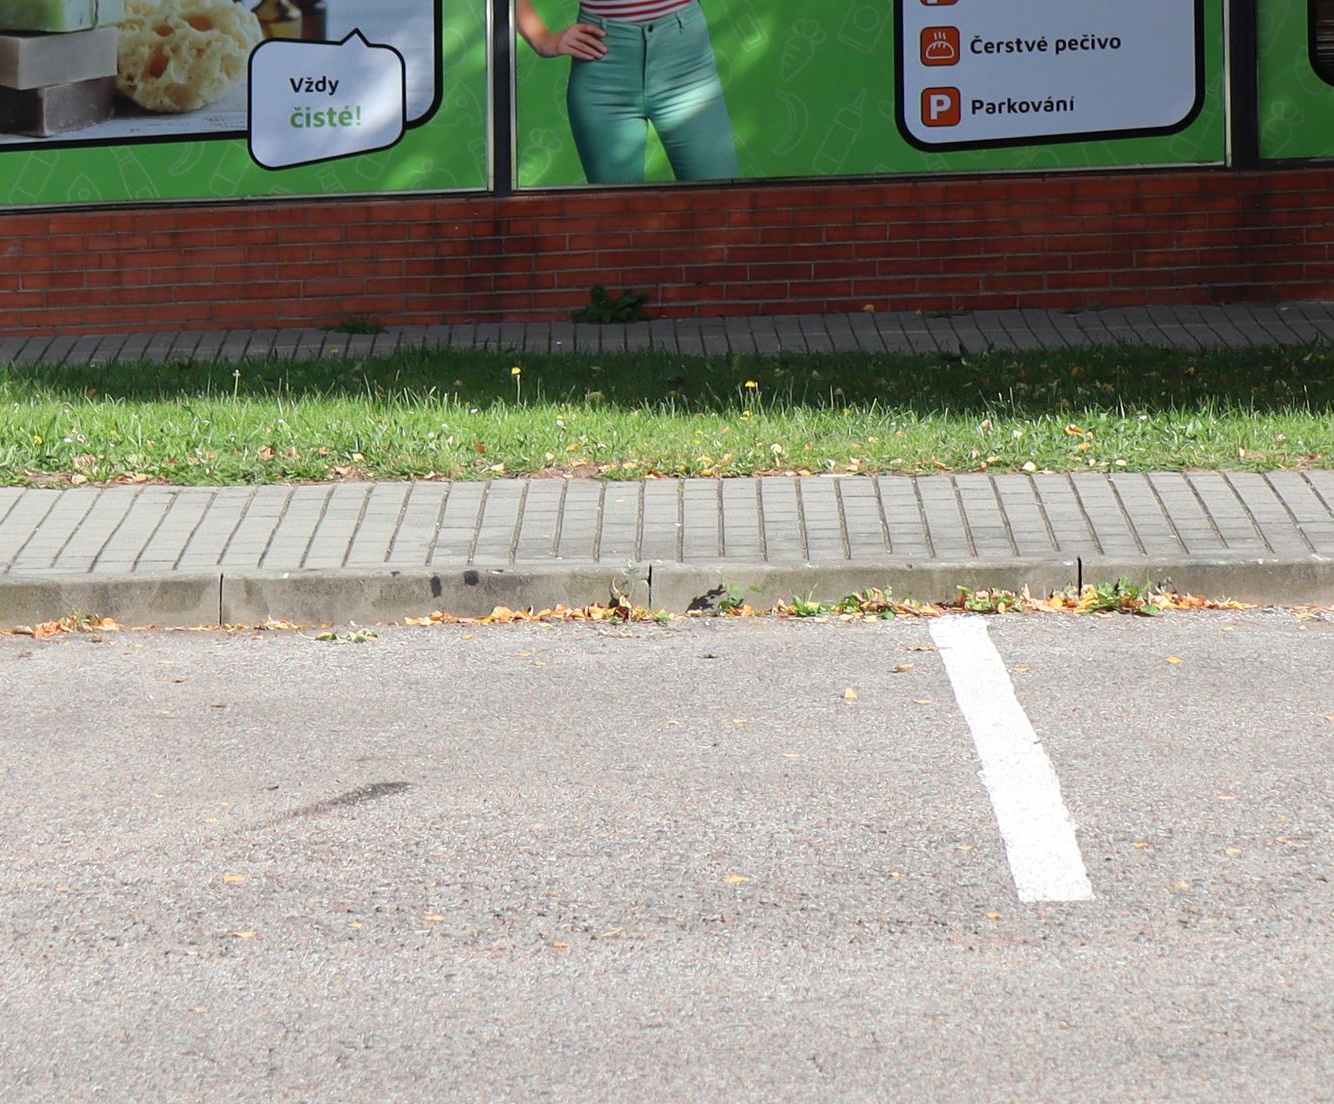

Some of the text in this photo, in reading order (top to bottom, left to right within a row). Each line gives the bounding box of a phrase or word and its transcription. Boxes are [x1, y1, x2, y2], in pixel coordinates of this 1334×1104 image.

[970, 33, 1122, 55] Čerstvé pečivo
[289, 75, 340, 96] Vždy
[290, 104, 362, 129] čisté!
[930, 94, 1075, 120] P Parkování
